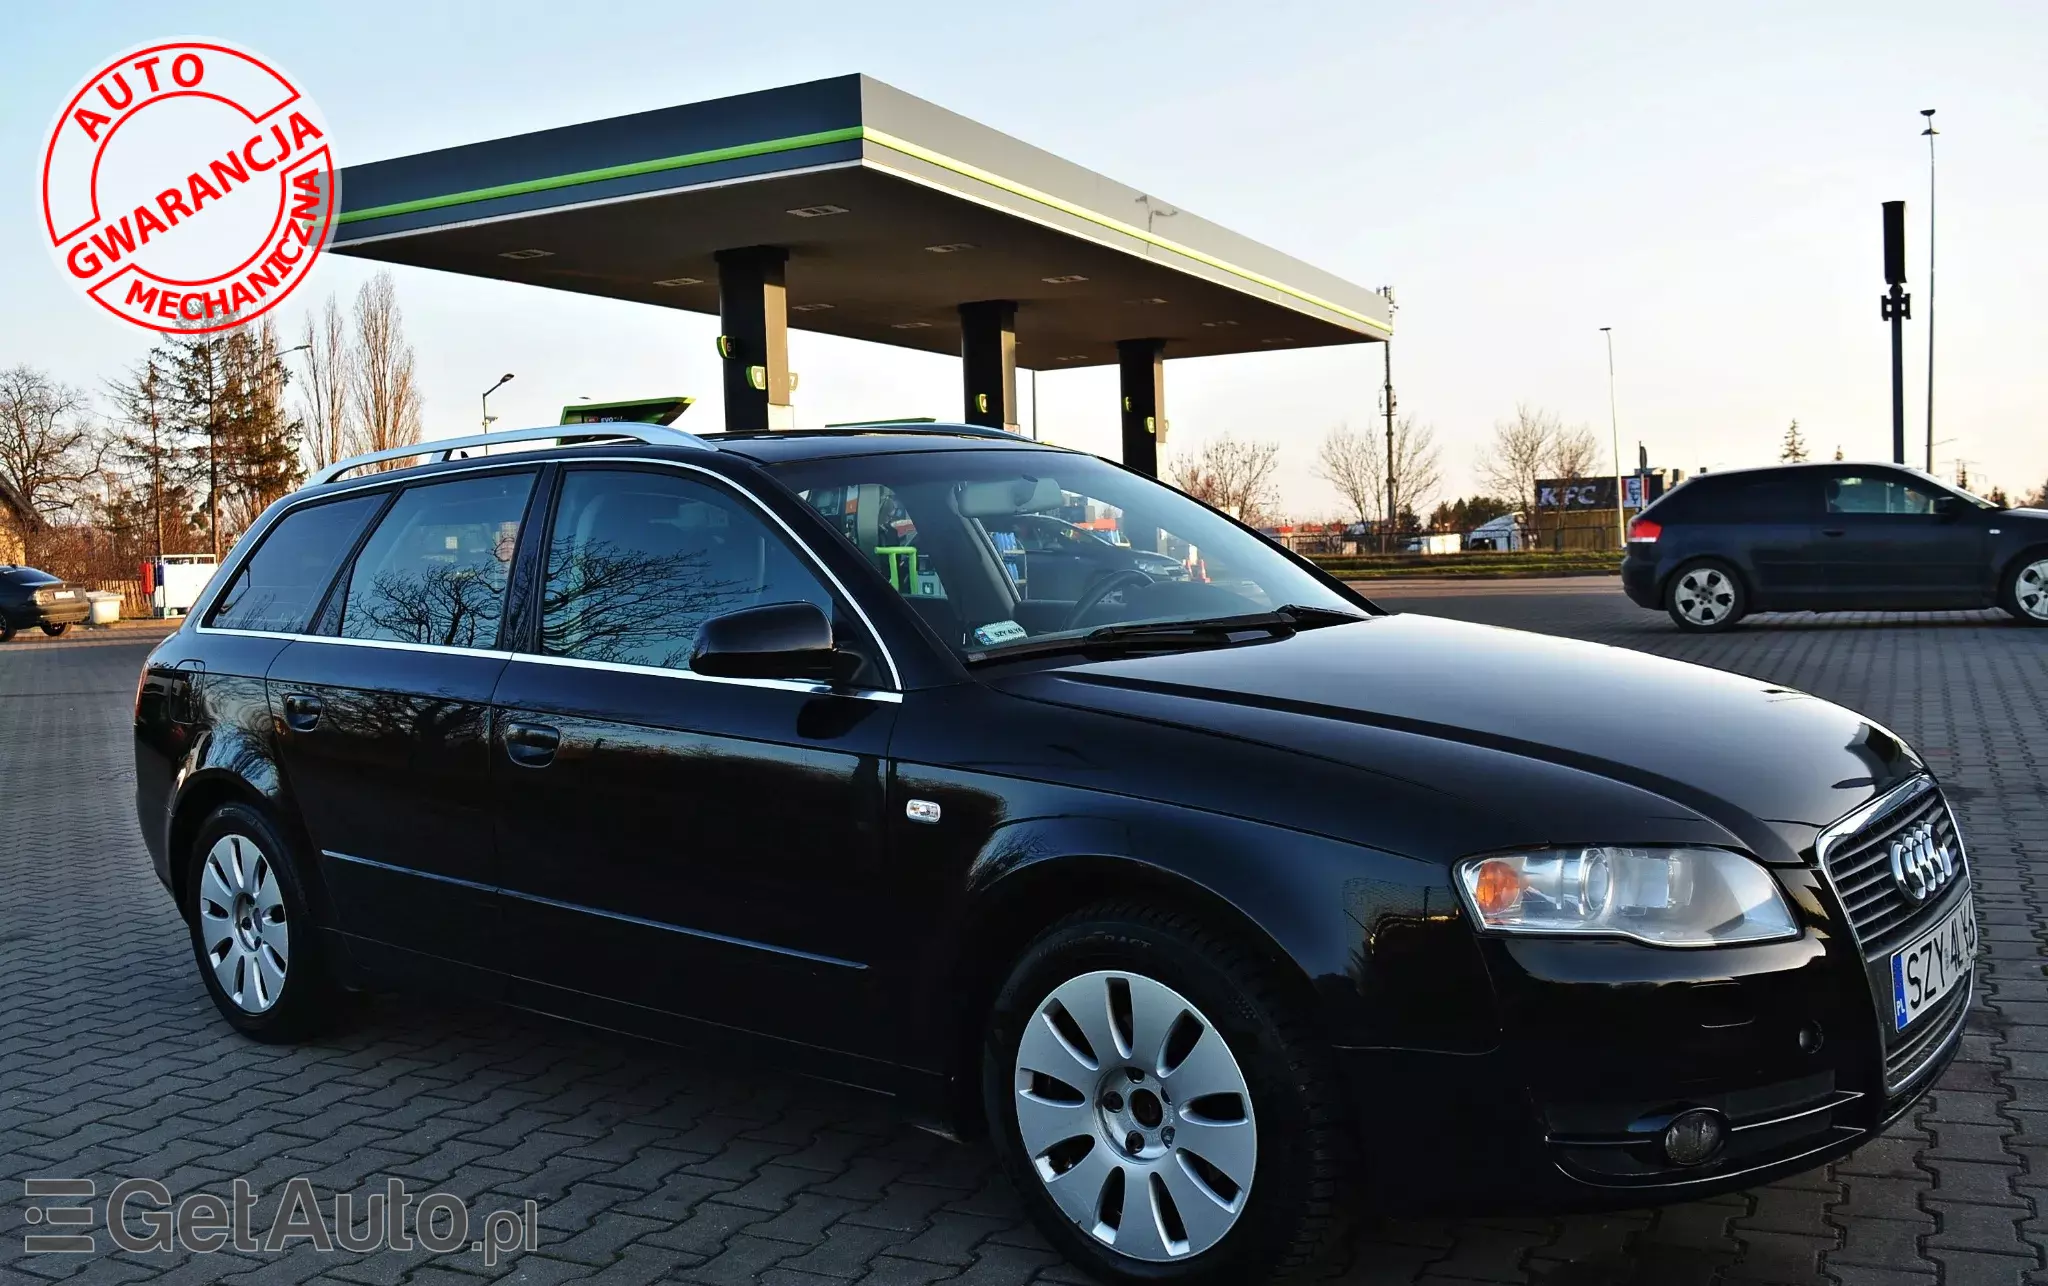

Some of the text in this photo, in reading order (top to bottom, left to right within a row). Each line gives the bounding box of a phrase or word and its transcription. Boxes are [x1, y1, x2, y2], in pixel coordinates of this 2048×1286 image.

[1540, 486, 1596, 506] KFC
[1907, 932, 1945, 1010] SZY
[1896, 999, 1905, 1016] PL
